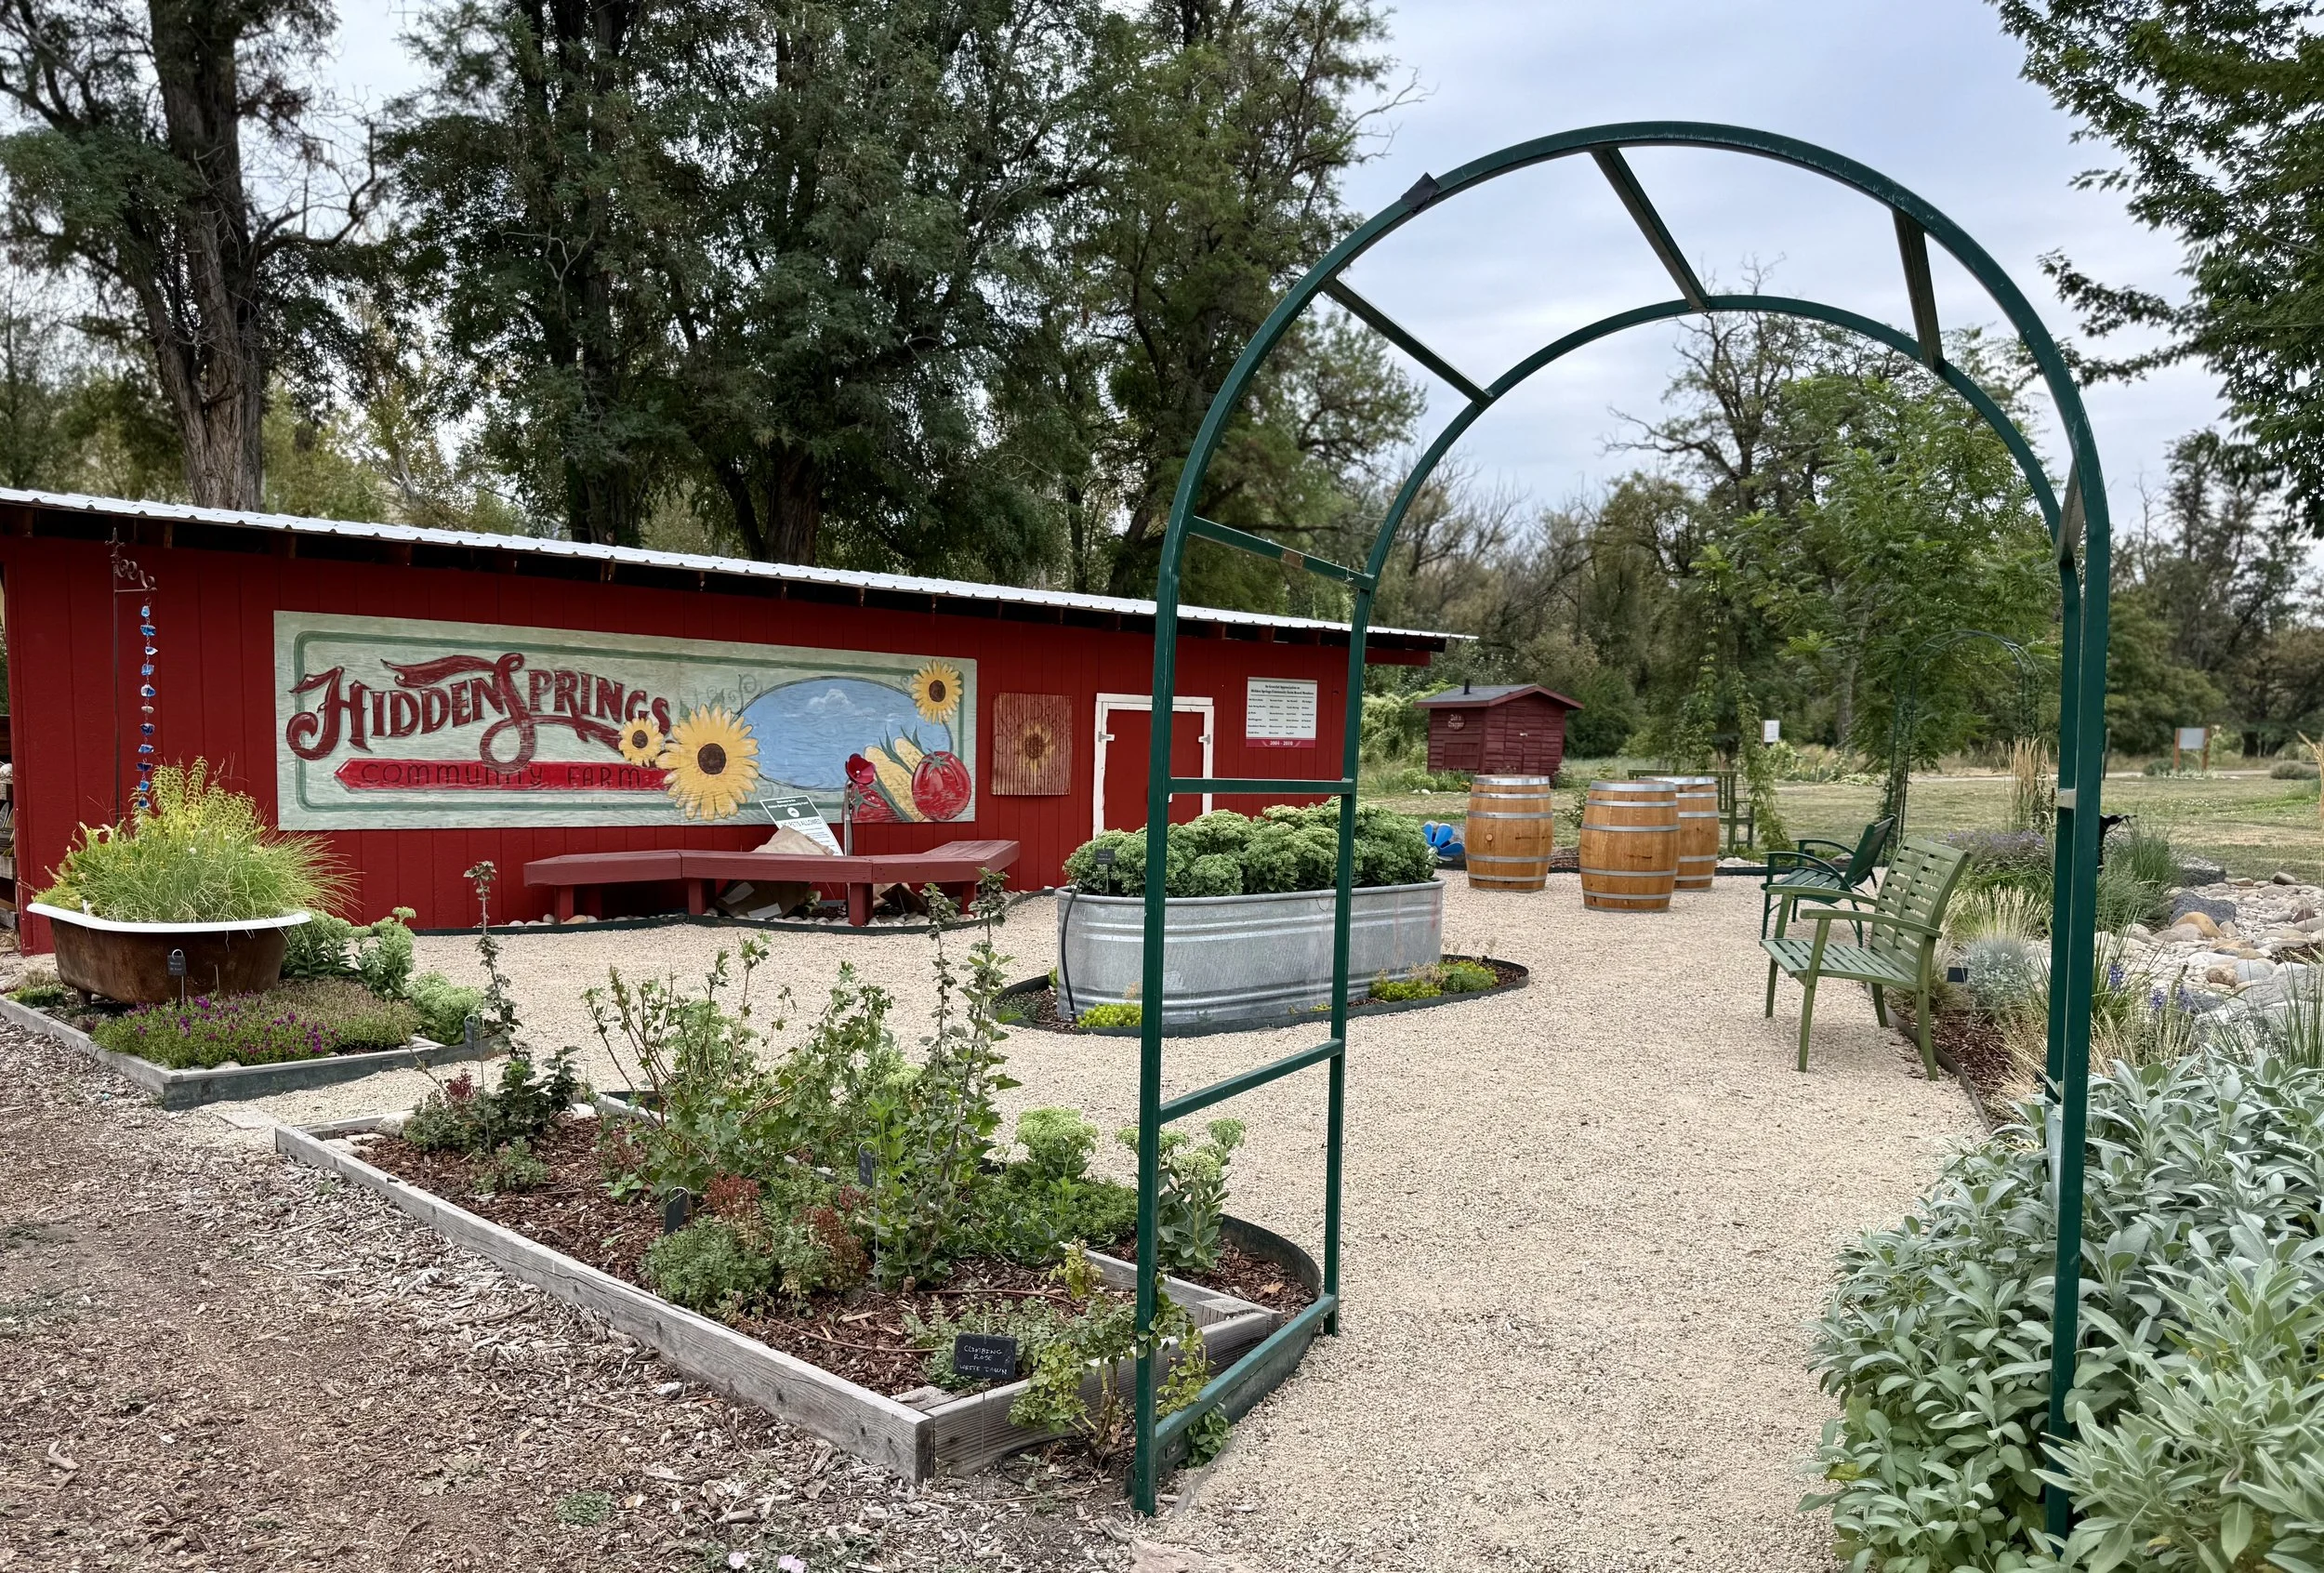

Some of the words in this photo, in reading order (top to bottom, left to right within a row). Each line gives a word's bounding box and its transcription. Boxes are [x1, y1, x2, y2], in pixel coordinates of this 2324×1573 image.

[286, 665, 508, 760] HIDDEN
[479, 653, 671, 773] SPRINGS
[567, 766, 640, 787] FARM
